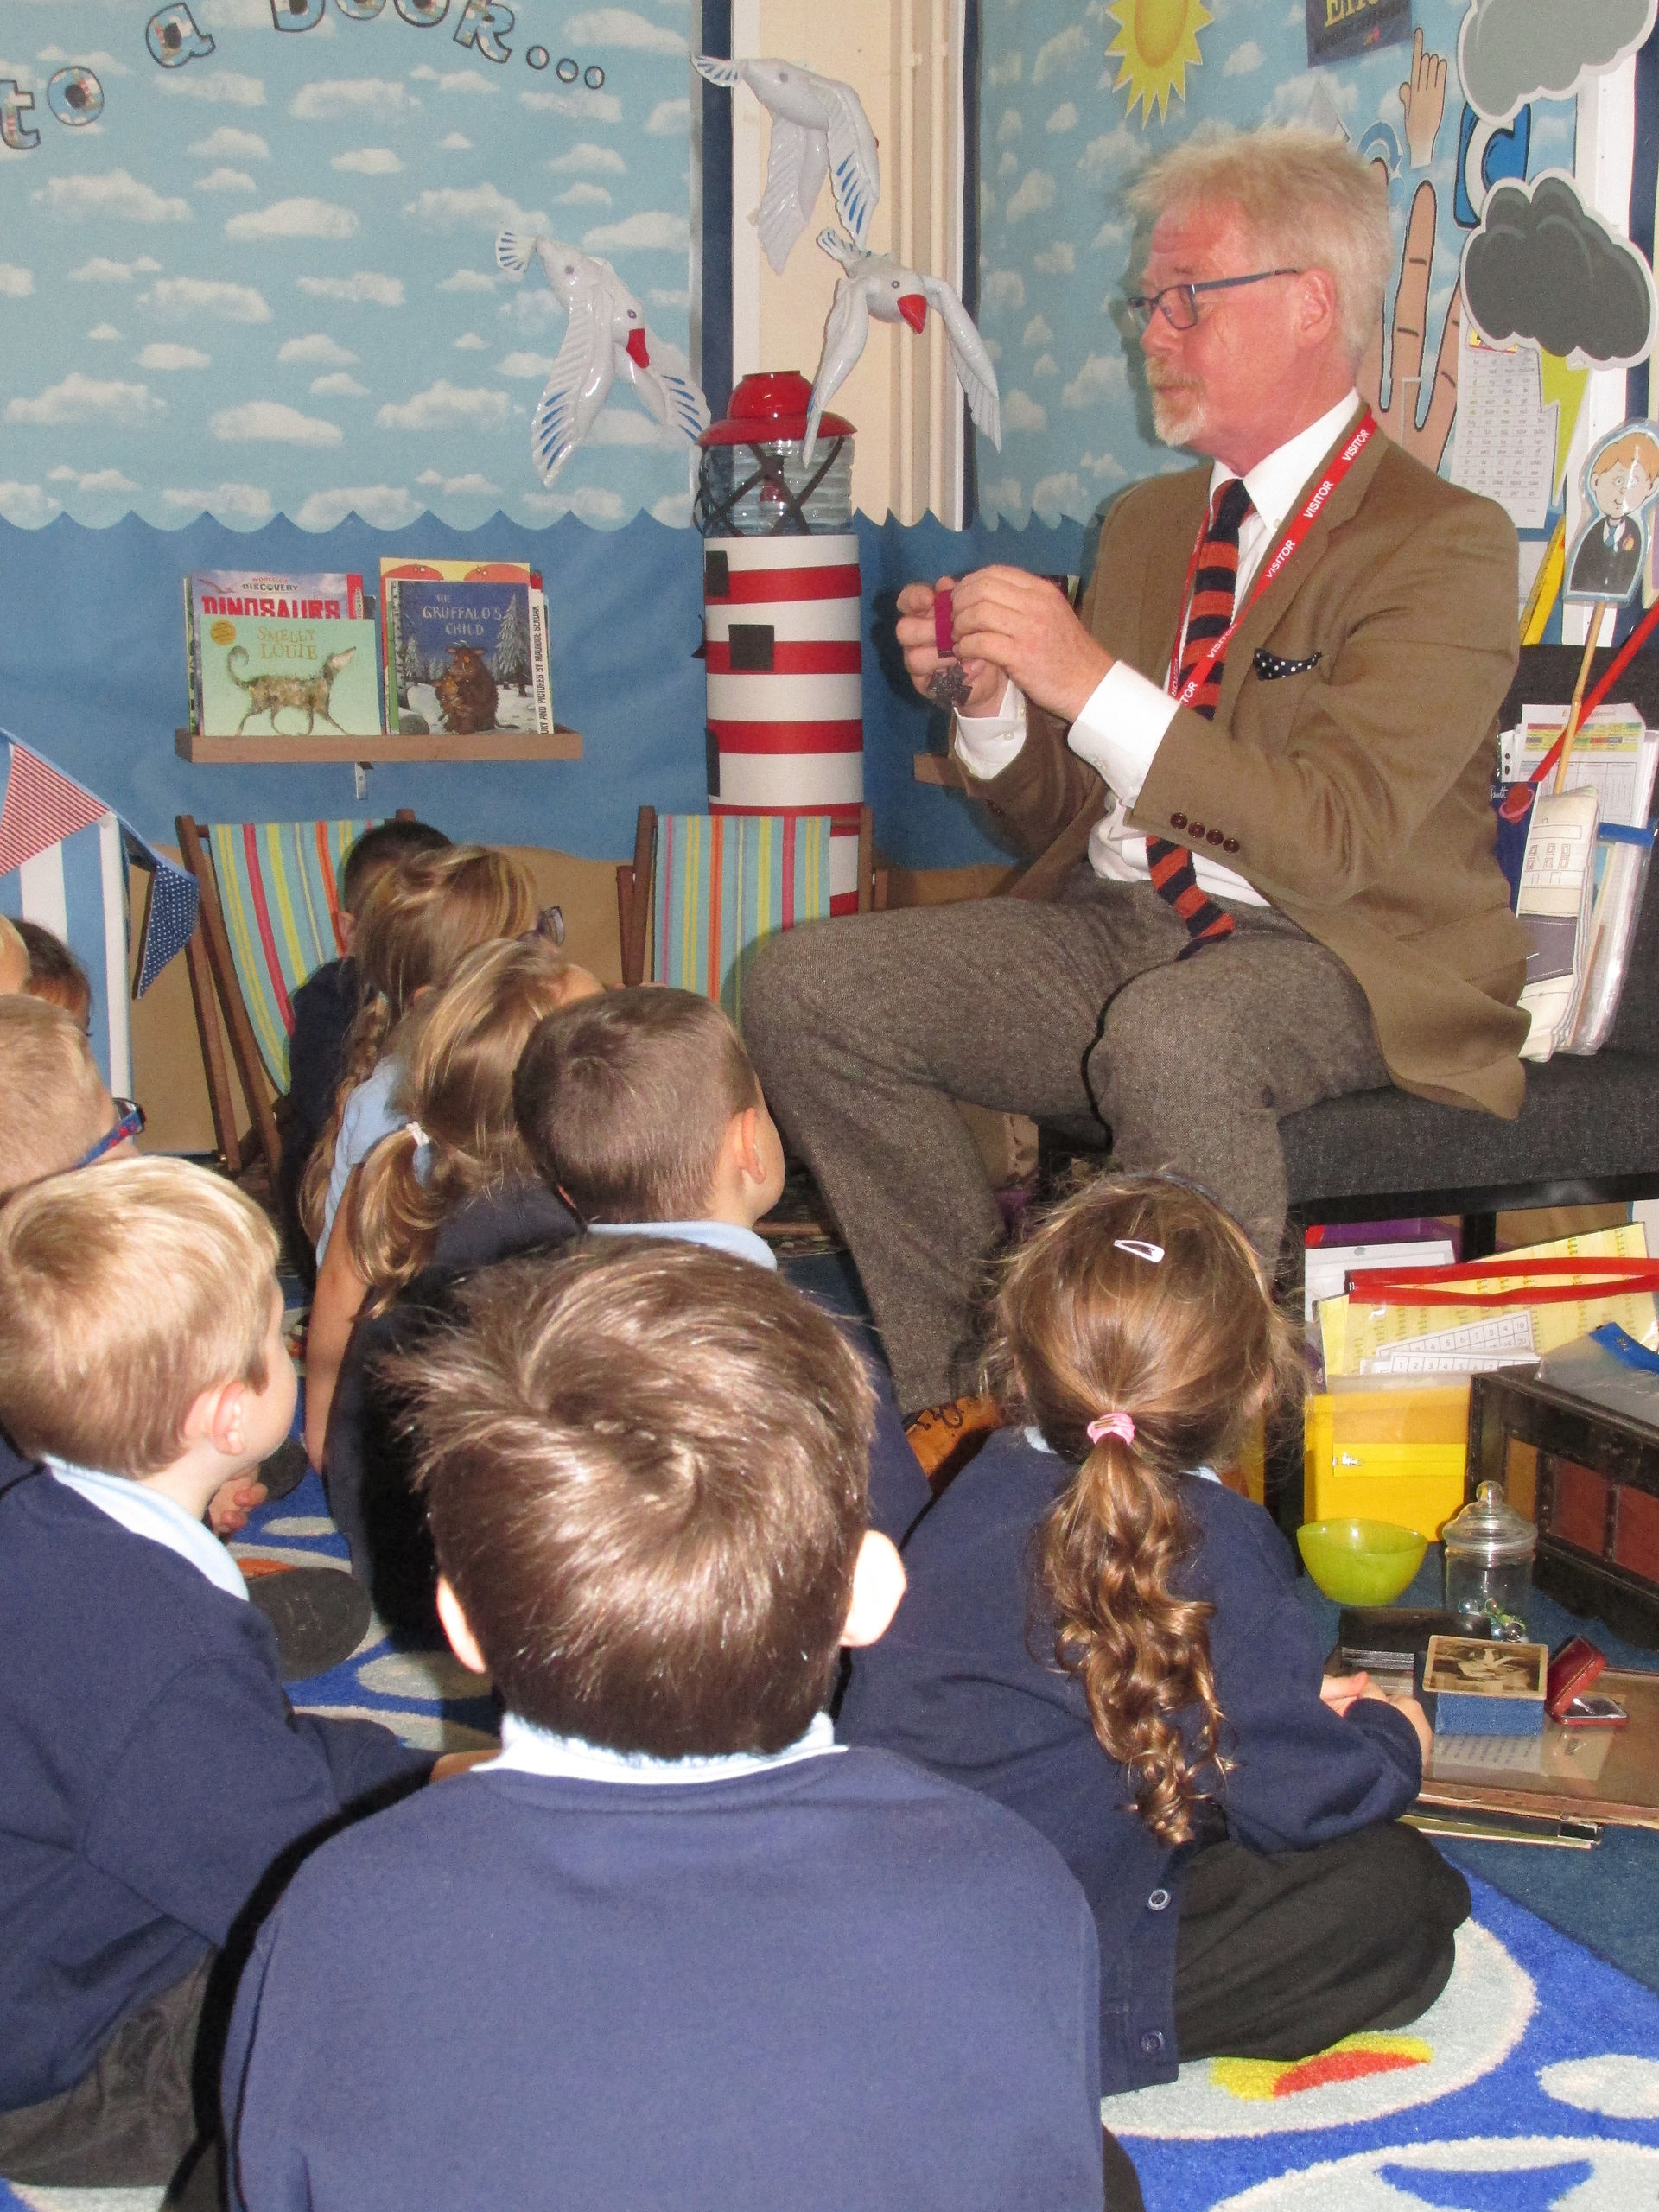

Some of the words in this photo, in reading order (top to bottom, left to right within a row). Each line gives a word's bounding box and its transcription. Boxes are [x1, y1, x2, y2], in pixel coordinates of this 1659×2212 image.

[1342, 429, 1370, 461] VISITOR
[1303, 480, 1334, 518] VISITOR
[1265, 539, 1296, 578] VISITOR
[242, 583, 299, 592] DISCOVERY
[201, 596, 340, 620] DINOSAURS
[257, 626, 315, 643] SMELLY
[445, 623, 485, 636] CHILD
[261, 643, 319, 660] LOUIE
[536, 675, 546, 704] PICTURES
